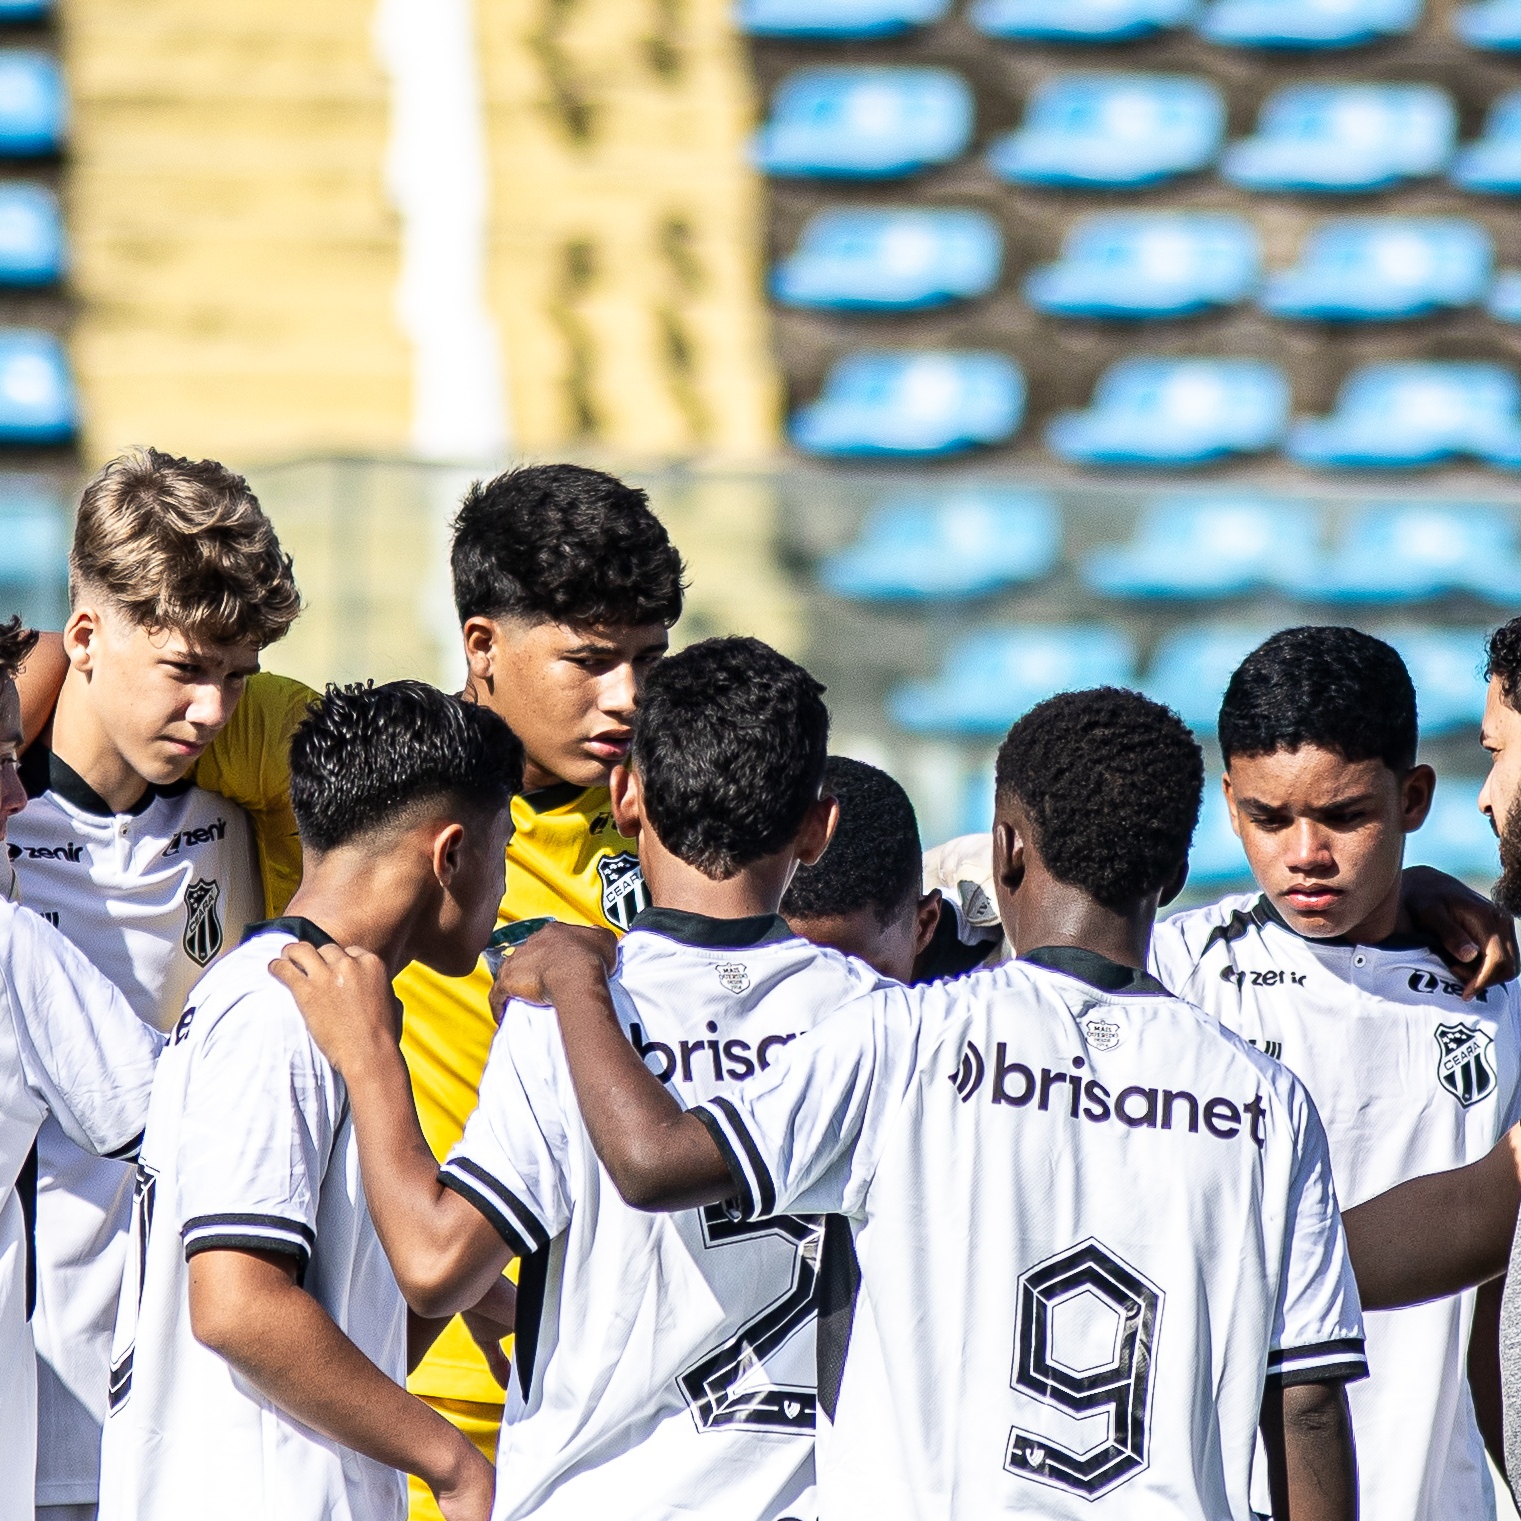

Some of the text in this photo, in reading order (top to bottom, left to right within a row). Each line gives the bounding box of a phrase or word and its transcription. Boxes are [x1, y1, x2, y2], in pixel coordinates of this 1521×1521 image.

[29, 842, 83, 863] zenir
[606, 872, 640, 903] CEAR
[991, 1041, 1267, 1149] brisanet
[675, 1206, 826, 1437] 2
[1003, 1236, 1166, 1502] 9
